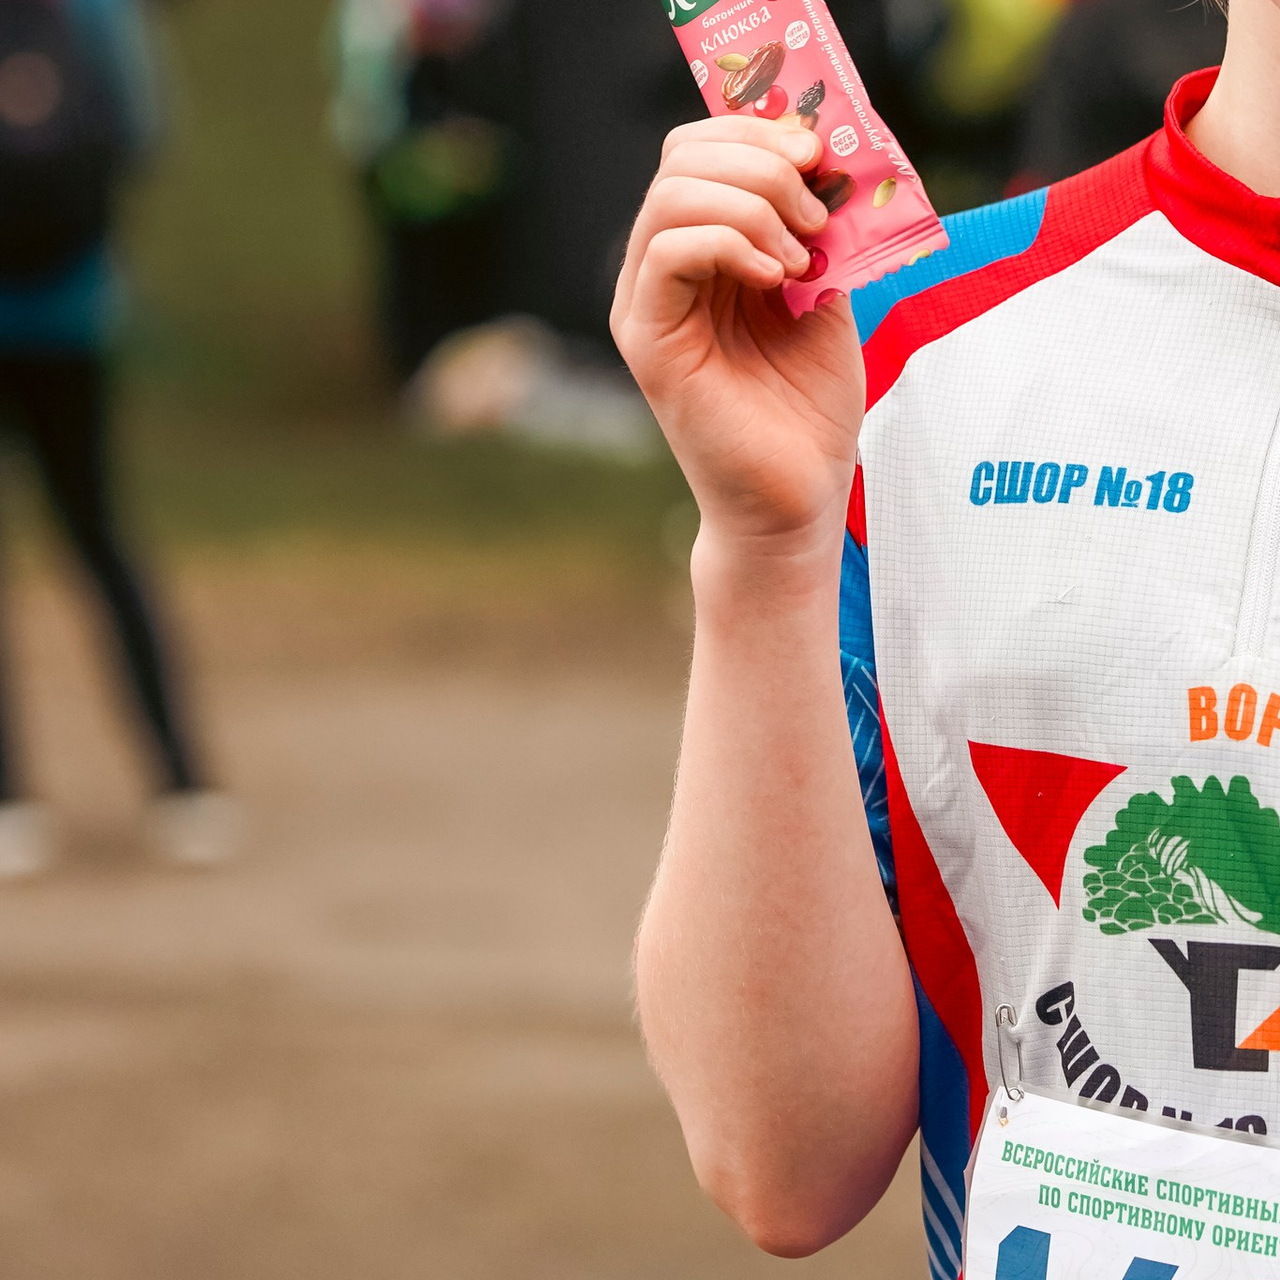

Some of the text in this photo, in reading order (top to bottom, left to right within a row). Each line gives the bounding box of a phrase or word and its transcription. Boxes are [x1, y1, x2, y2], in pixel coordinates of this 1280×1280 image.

[821, 43, 885, 151] фруктово-ореховый
[969, 461, 1194, 513] СШОР №18
[1001, 1140, 1149, 1196] ВСЕРОССИЙСКИЕ
[1038, 1184, 1061, 1209] ПО
[1067, 1191, 1206, 1241] СПОРТИВНОМУ
